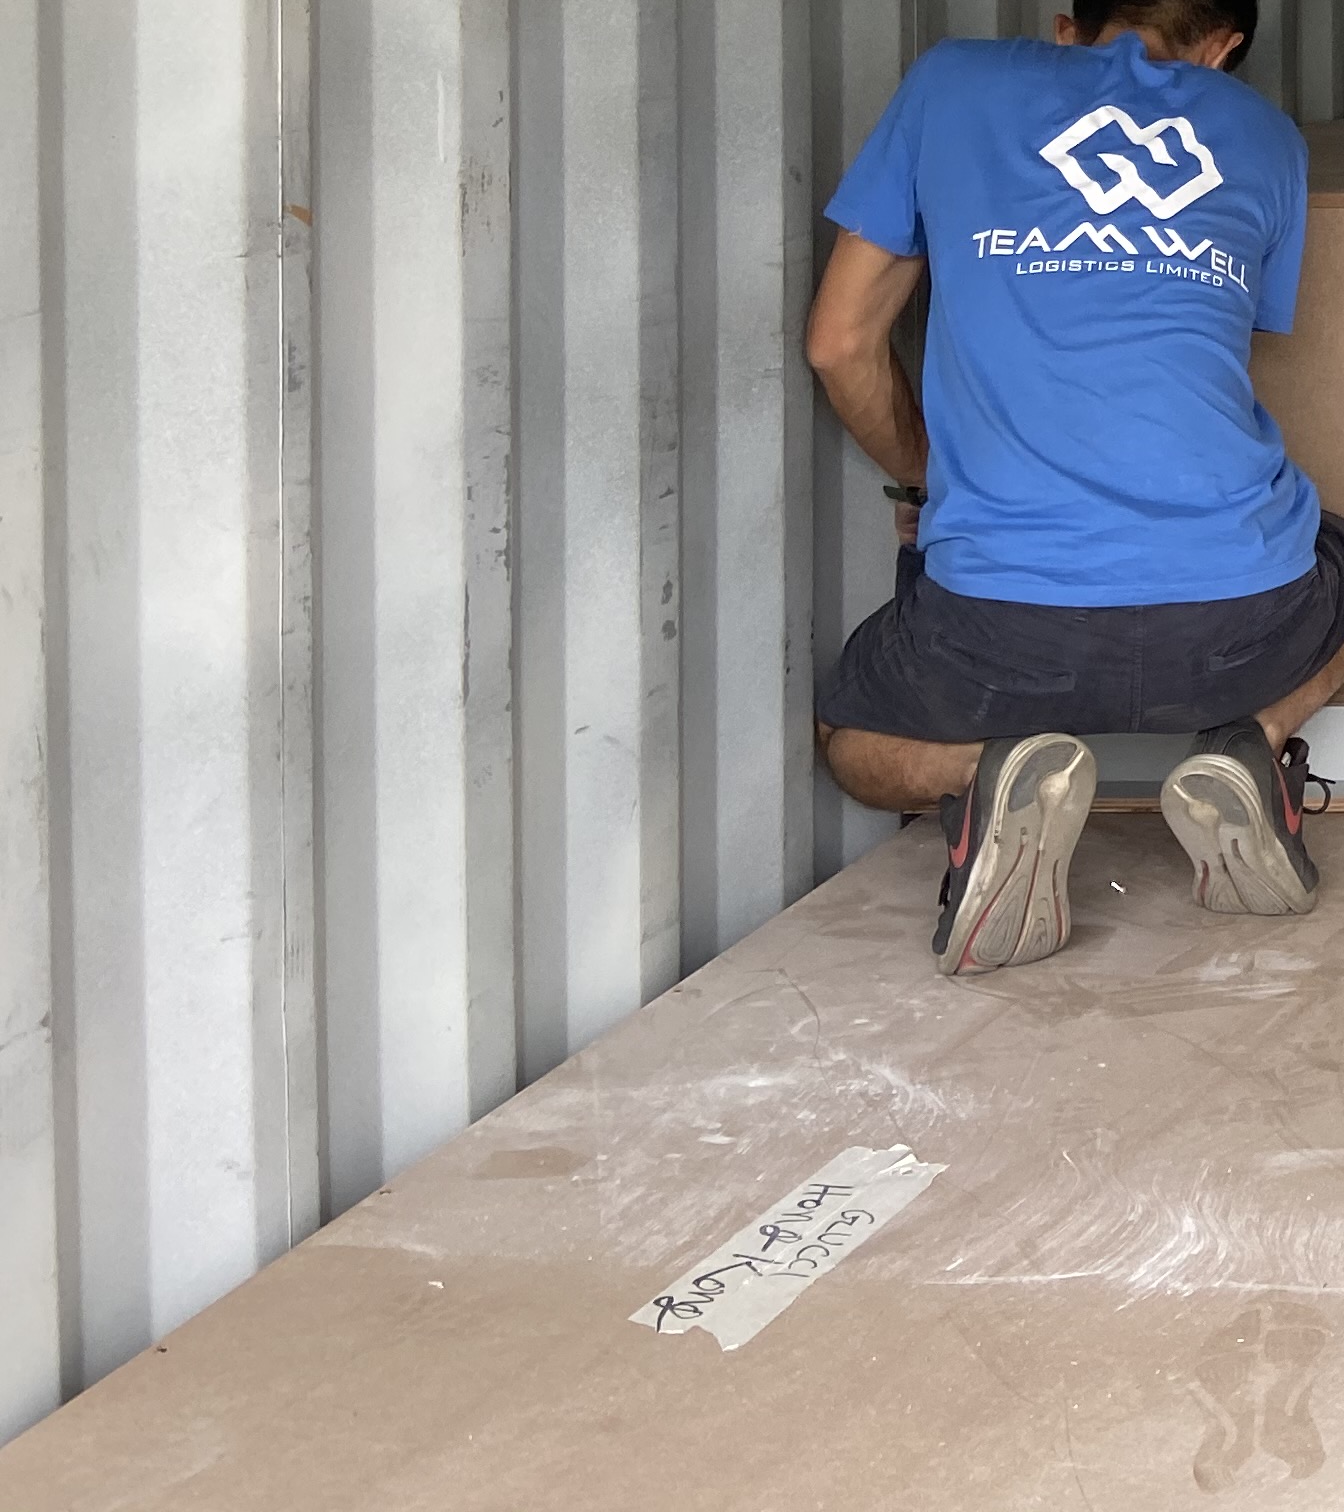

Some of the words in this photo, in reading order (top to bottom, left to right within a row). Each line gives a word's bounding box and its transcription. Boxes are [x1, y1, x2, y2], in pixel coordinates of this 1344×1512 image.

[1016, 259, 1135, 276] LOGISTICS
[1146, 260, 1224, 288] LIMITED
[758, 1183, 855, 1253] Hong
[768, 1209, 876, 1278] GUCCI
[652, 1252, 786, 1333] Kong
